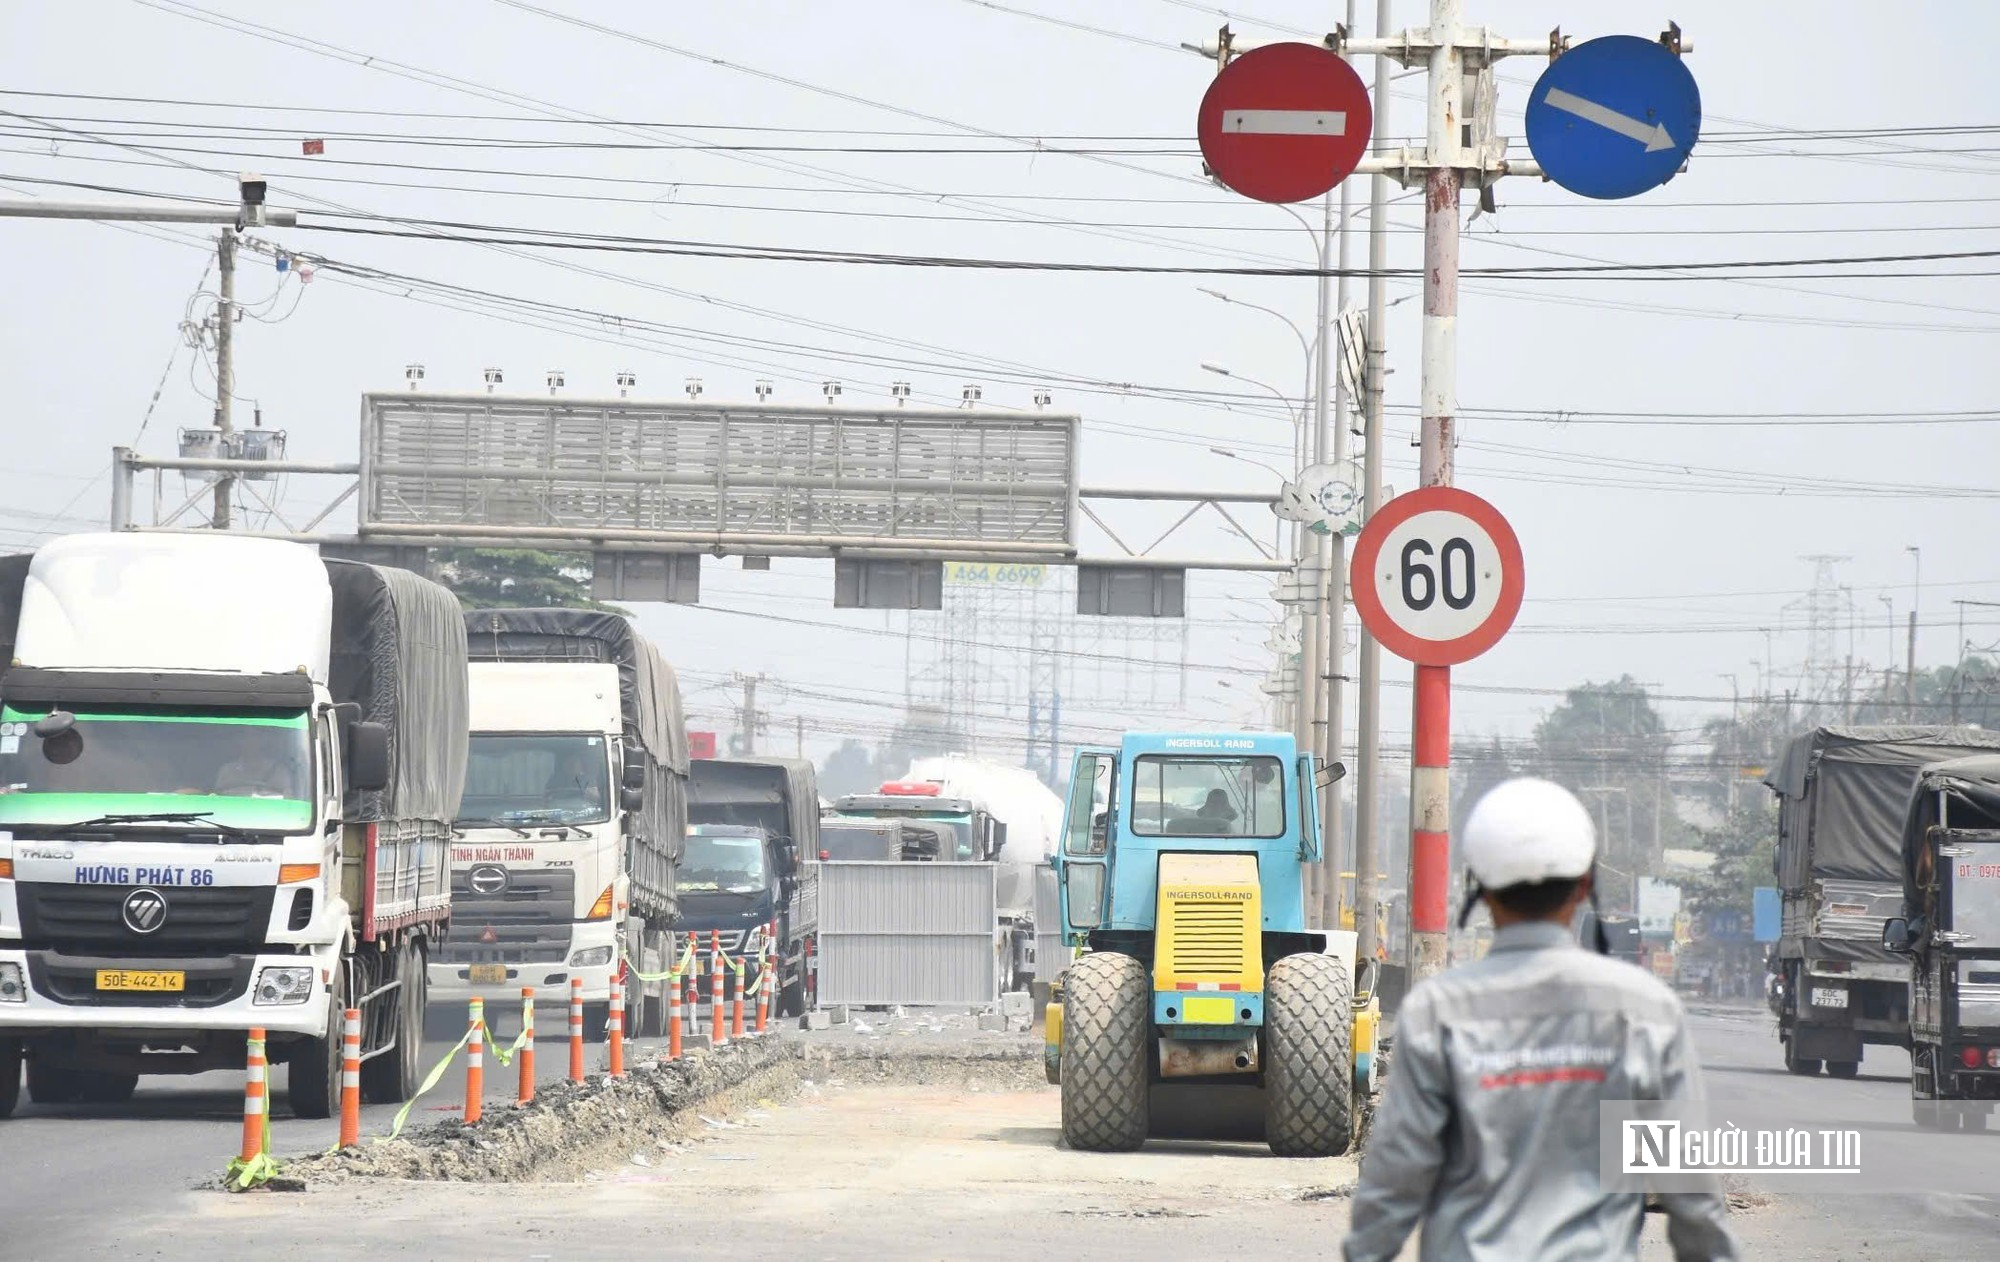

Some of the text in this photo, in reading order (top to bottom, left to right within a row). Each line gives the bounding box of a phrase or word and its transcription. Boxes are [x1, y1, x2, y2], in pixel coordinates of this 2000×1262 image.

[1401, 537, 1476, 612] 60
[1165, 738, 1221, 749] INGERSOLL
[20, 848, 75, 860] THACO
[544, 860, 574, 868] 700
[75, 864, 214, 886] HƯNG PHÁT 86
[103, 973, 177, 989] 50E-442.14
